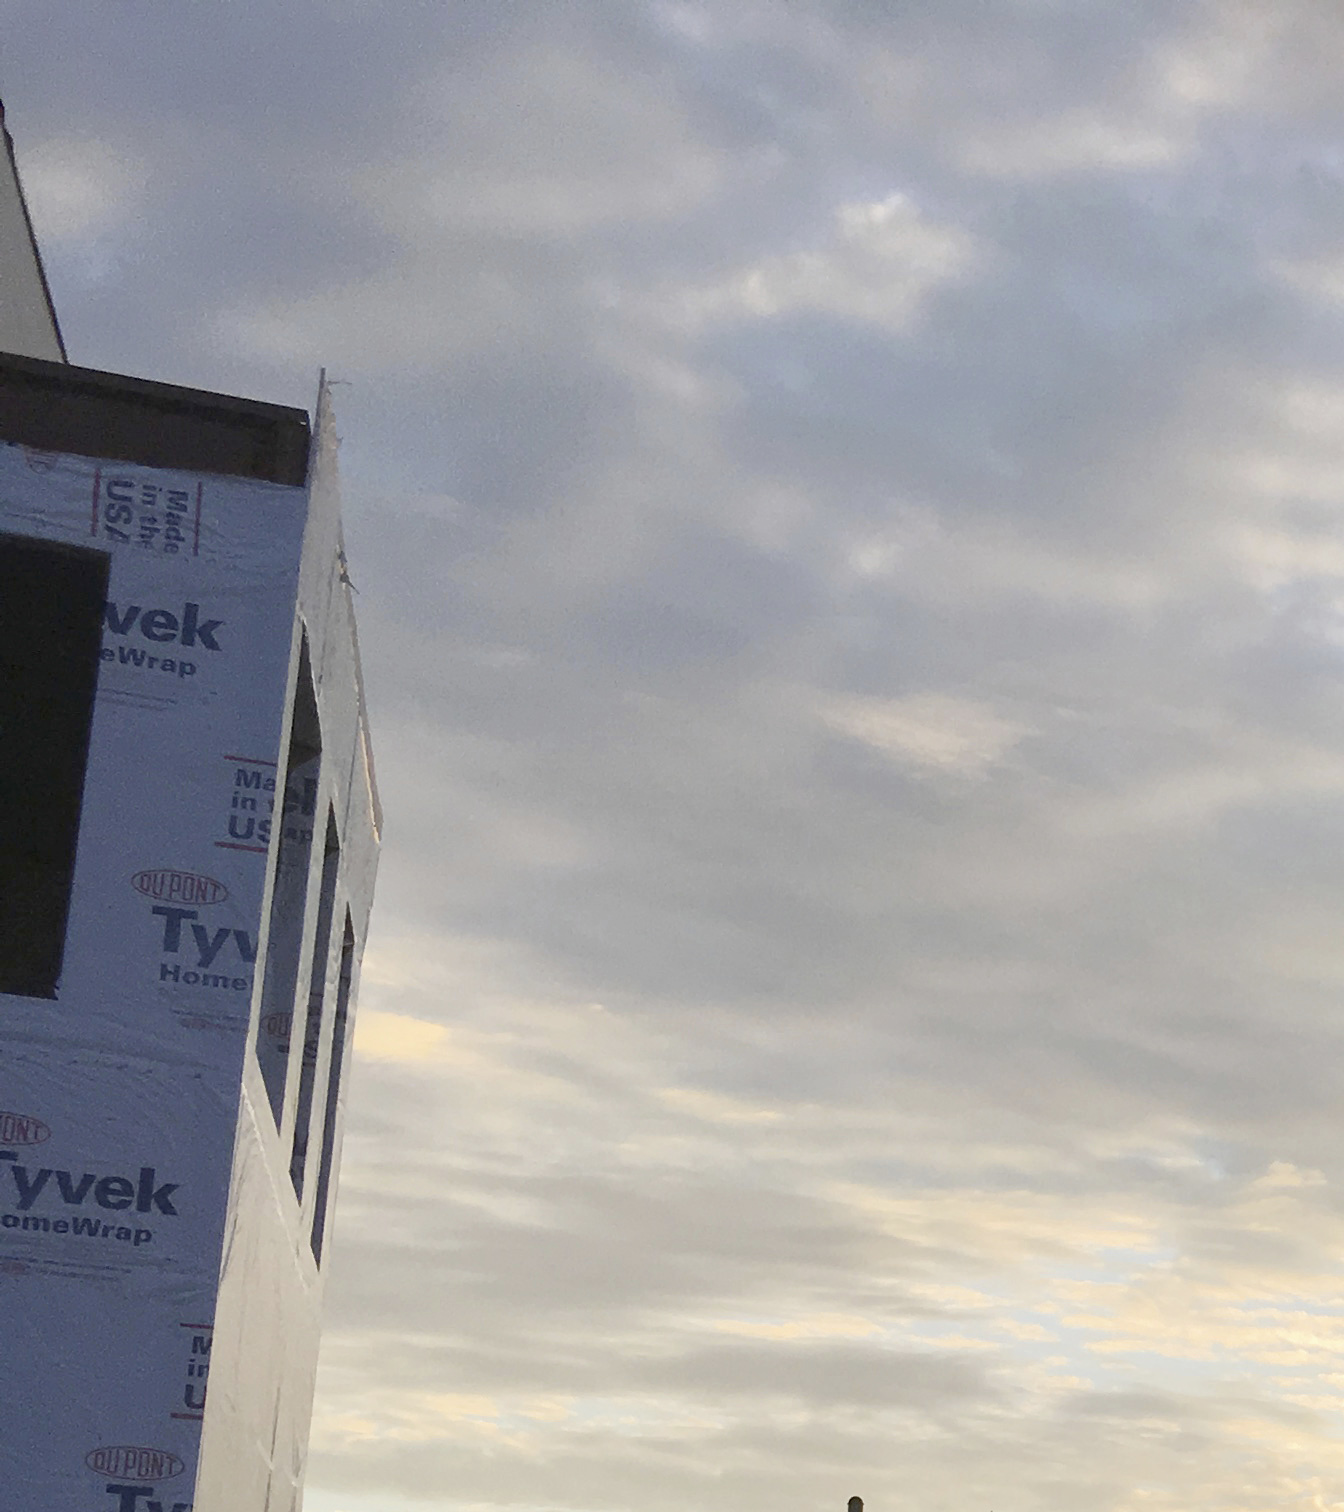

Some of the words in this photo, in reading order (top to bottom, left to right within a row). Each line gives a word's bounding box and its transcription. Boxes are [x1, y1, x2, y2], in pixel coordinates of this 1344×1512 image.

[141, 485, 162, 506] in
[163, 489, 189, 554] Made
[103, 602, 225, 651] vek
[101, 646, 196, 678] eWrap
[229, 815, 272, 843] US
[152, 905, 256, 968] Tyv
[160, 963, 248, 991] Home
[0, 1214, 153, 1246] omeWrap
